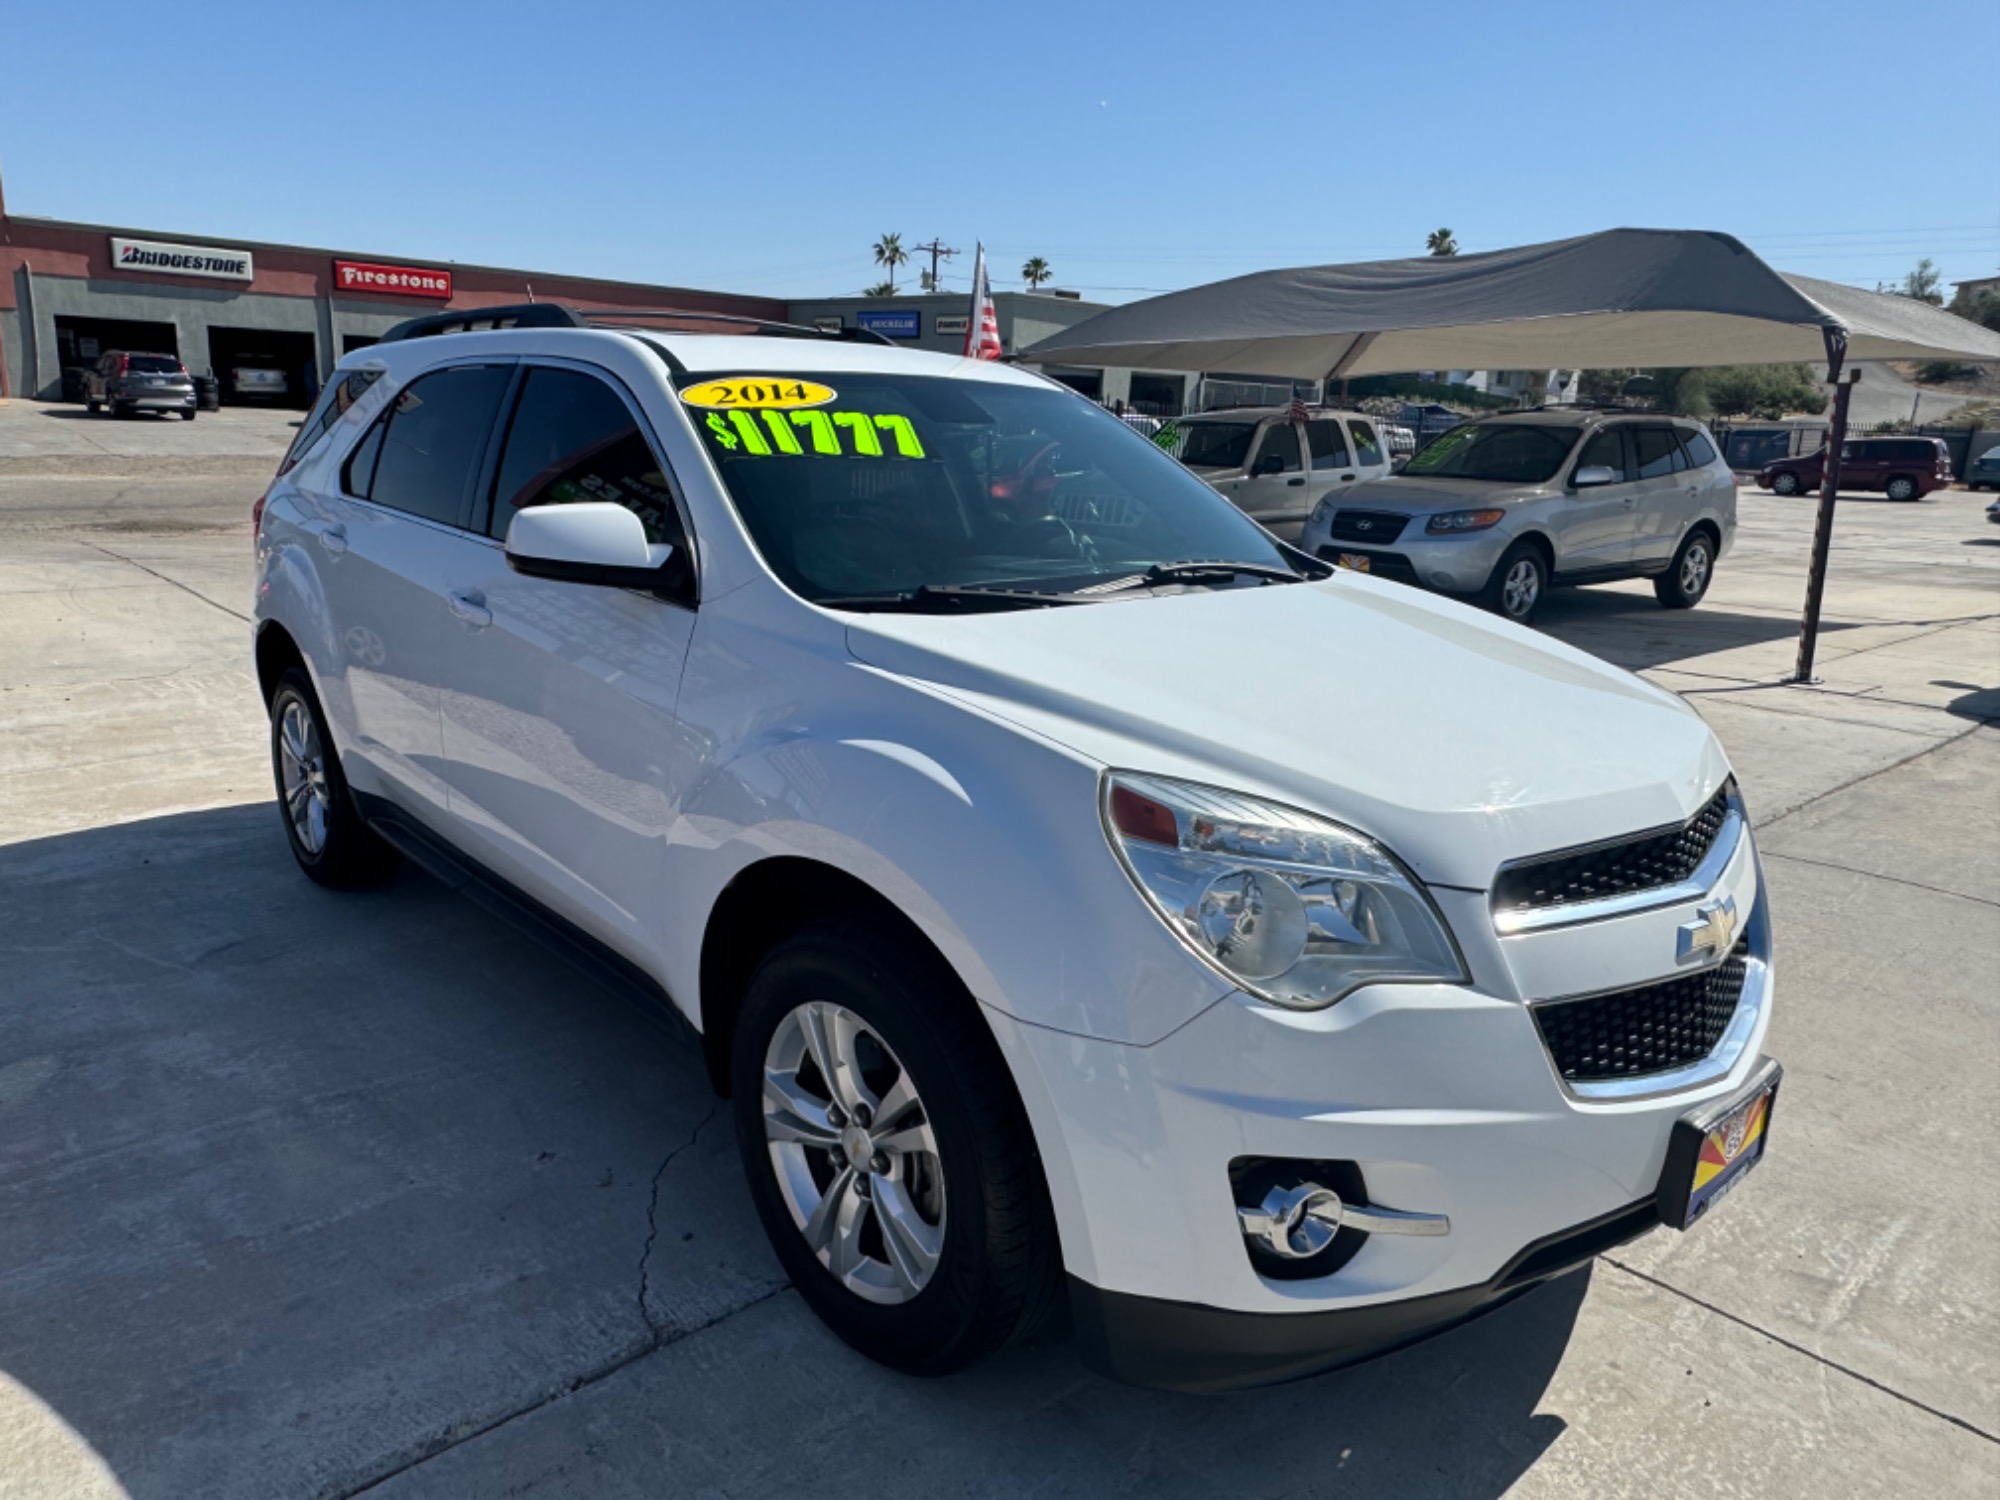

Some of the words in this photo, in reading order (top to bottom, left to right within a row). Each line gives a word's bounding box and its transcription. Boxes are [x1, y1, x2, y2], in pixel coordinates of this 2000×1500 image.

[121, 246, 246, 274] BRIDGESTONE
[342, 267, 447, 290] Firestone
[710, 383, 809, 405] 2014
[706, 410, 925, 459] $11777
